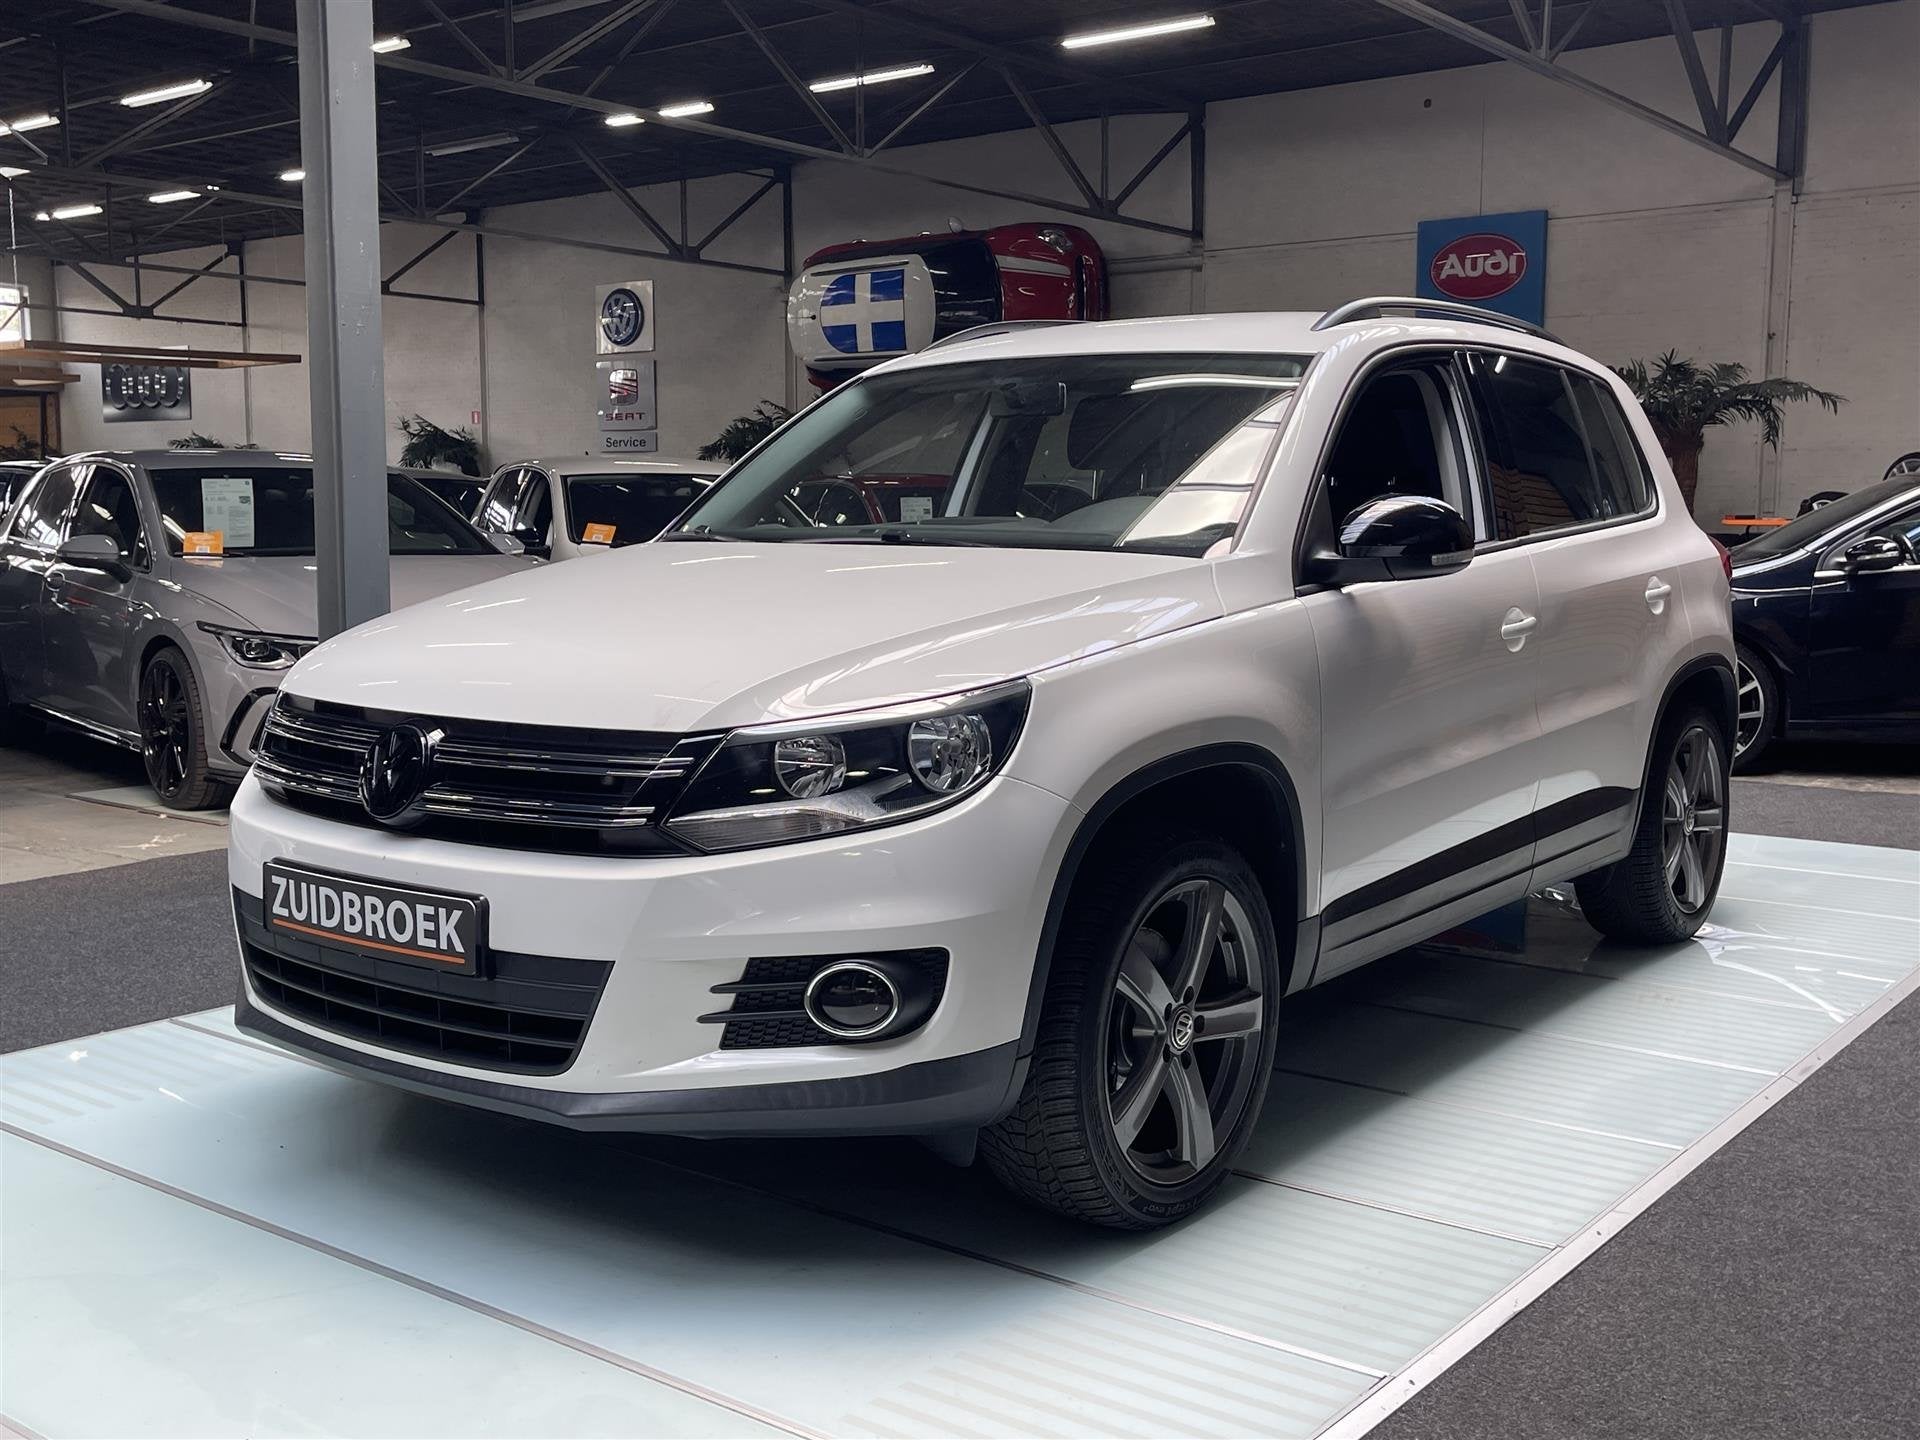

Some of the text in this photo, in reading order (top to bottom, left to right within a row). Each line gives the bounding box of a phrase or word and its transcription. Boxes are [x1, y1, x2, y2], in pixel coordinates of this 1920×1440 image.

[1438, 249, 1517, 280] Audi
[605, 412, 646, 421] SEAT
[605, 437, 647, 448] Service
[271, 874, 465, 953] ZUIDBROEK
